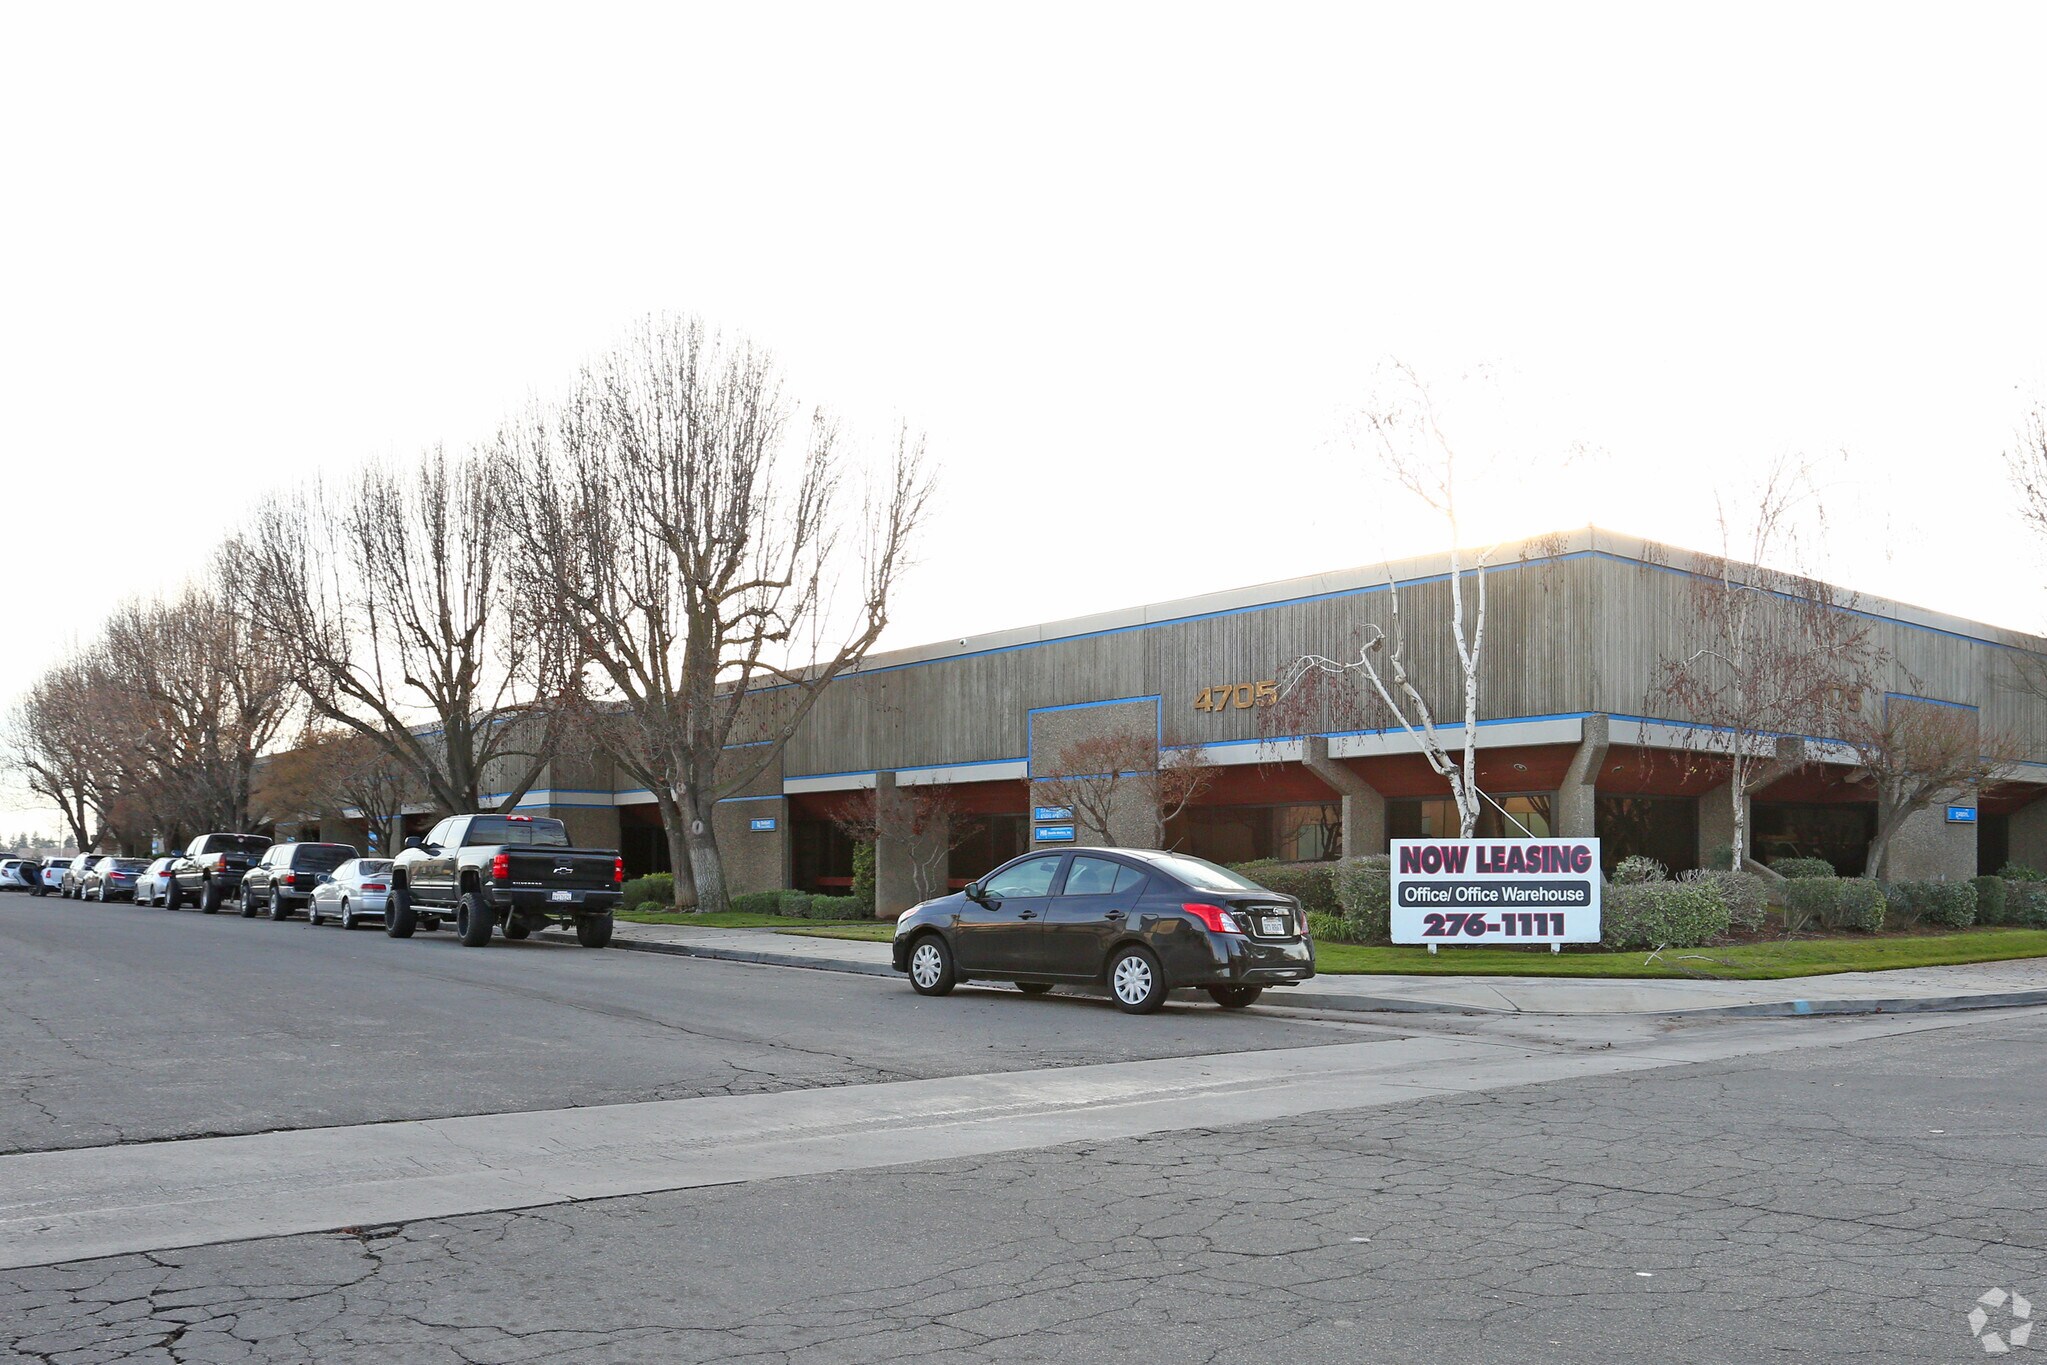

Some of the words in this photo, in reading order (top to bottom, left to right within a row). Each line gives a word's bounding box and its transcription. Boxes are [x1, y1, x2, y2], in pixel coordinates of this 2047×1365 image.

[1194, 680, 1278, 712] 4705
[1399, 845, 1470, 874] NOW
[1476, 845, 1592, 874] LEASING
[1404, 886, 1452, 902] Office/
[1455, 887, 1499, 902] Office
[1502, 886, 1585, 902] Warehouse
[1422, 912, 1565, 937] 276-1111
